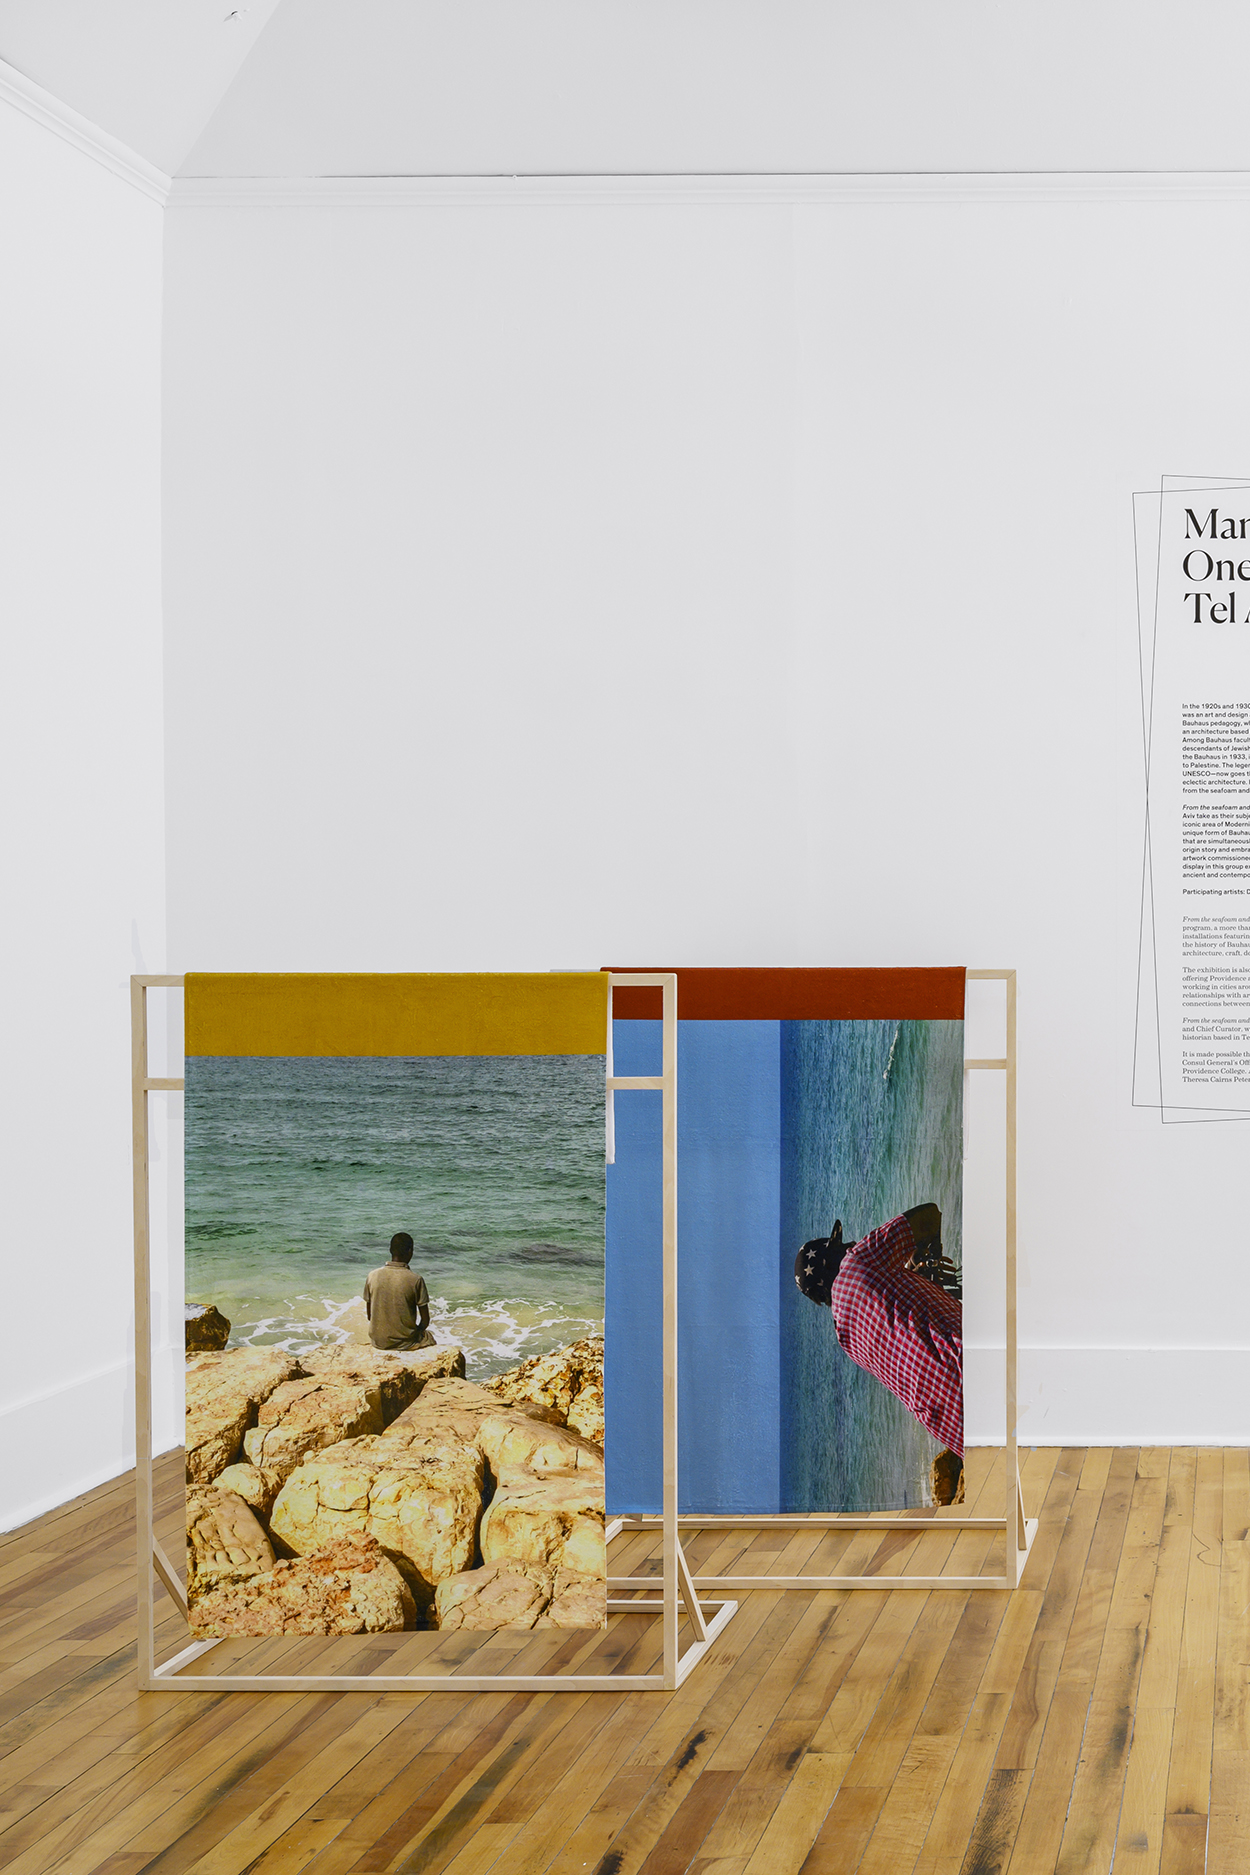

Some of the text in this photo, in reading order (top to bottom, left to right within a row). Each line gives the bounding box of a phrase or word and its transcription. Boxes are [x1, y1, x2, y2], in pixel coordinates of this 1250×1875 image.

[1184, 591, 1235, 624] Tel
[1227, 711, 1249, 719] design
[1182, 737, 1205, 745] Among
[1182, 889, 1223, 897] Participating
[1181, 975, 1209, 983] offering
[1182, 992, 1225, 1000] relationships
